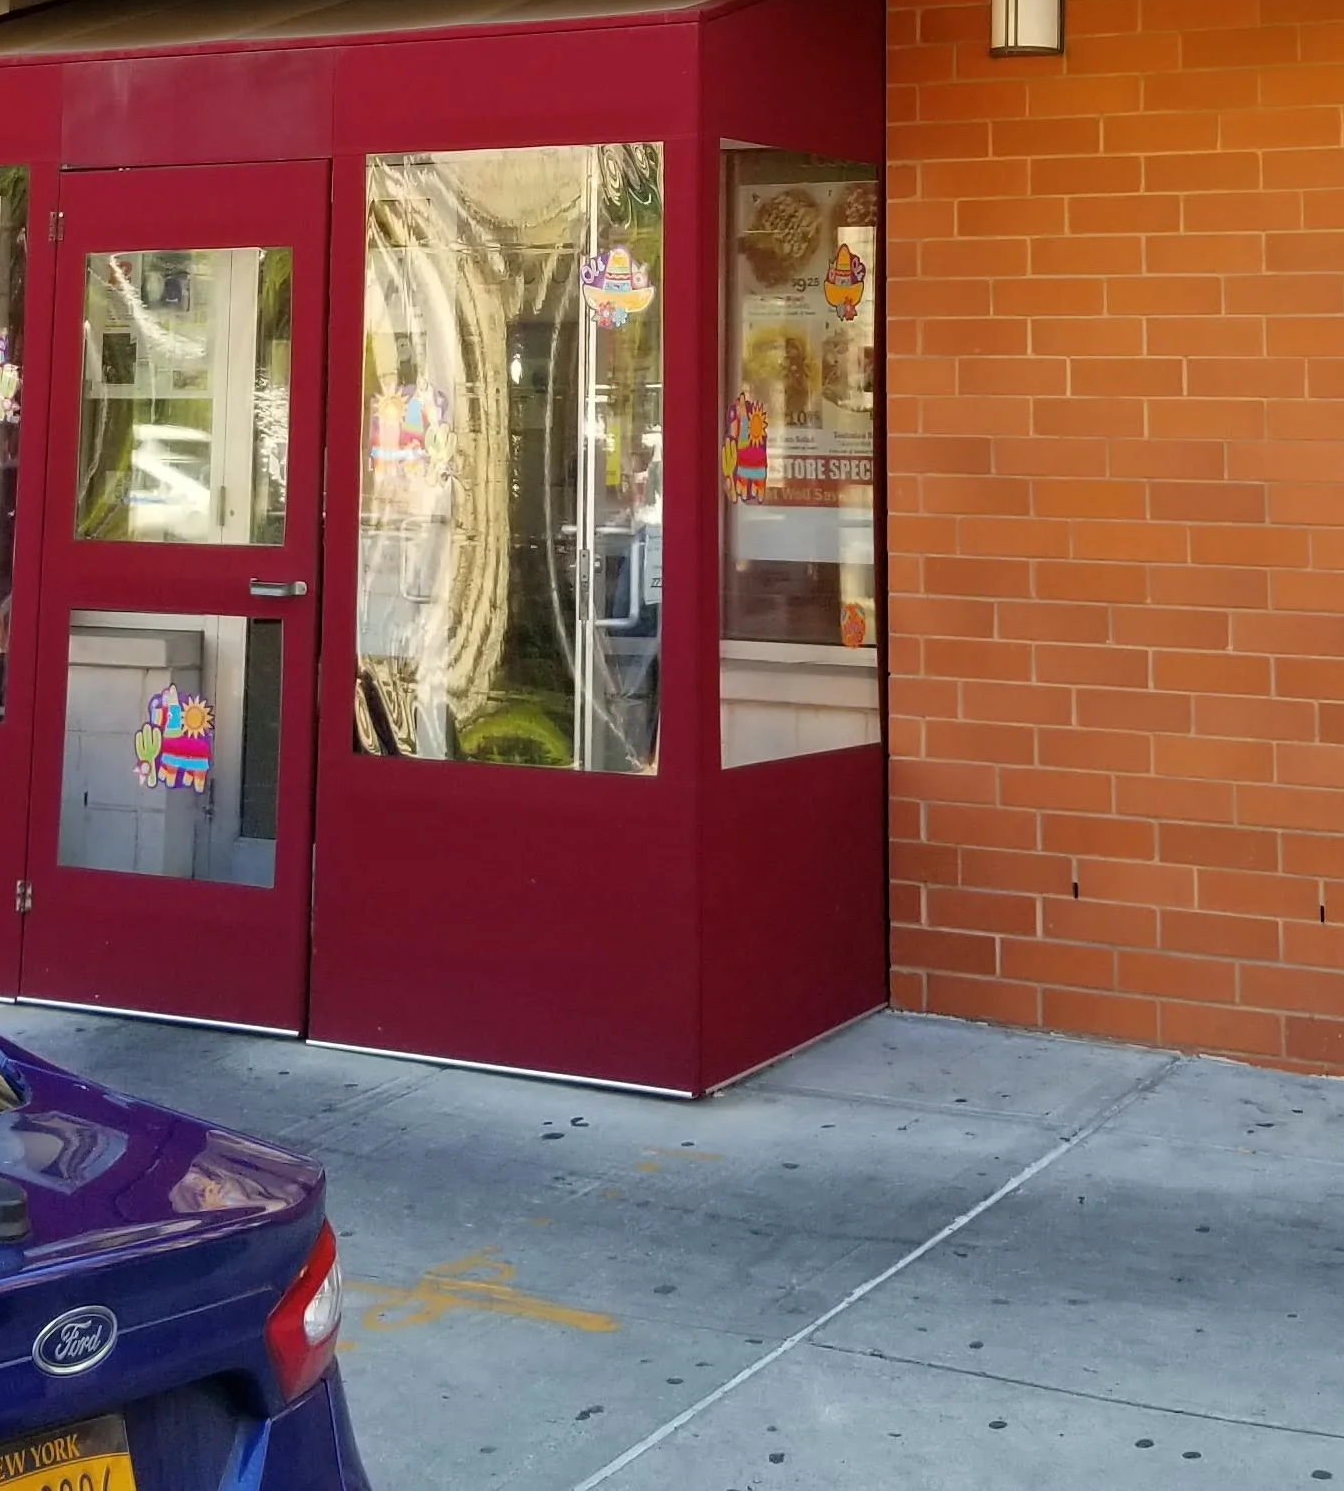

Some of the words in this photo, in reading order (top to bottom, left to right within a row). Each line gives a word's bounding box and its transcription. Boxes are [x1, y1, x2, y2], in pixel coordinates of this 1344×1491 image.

[829, 459, 874, 481] SPEC
[55, 1320, 103, 1360] Ford
[30, 1434, 80, 1468] YORK
